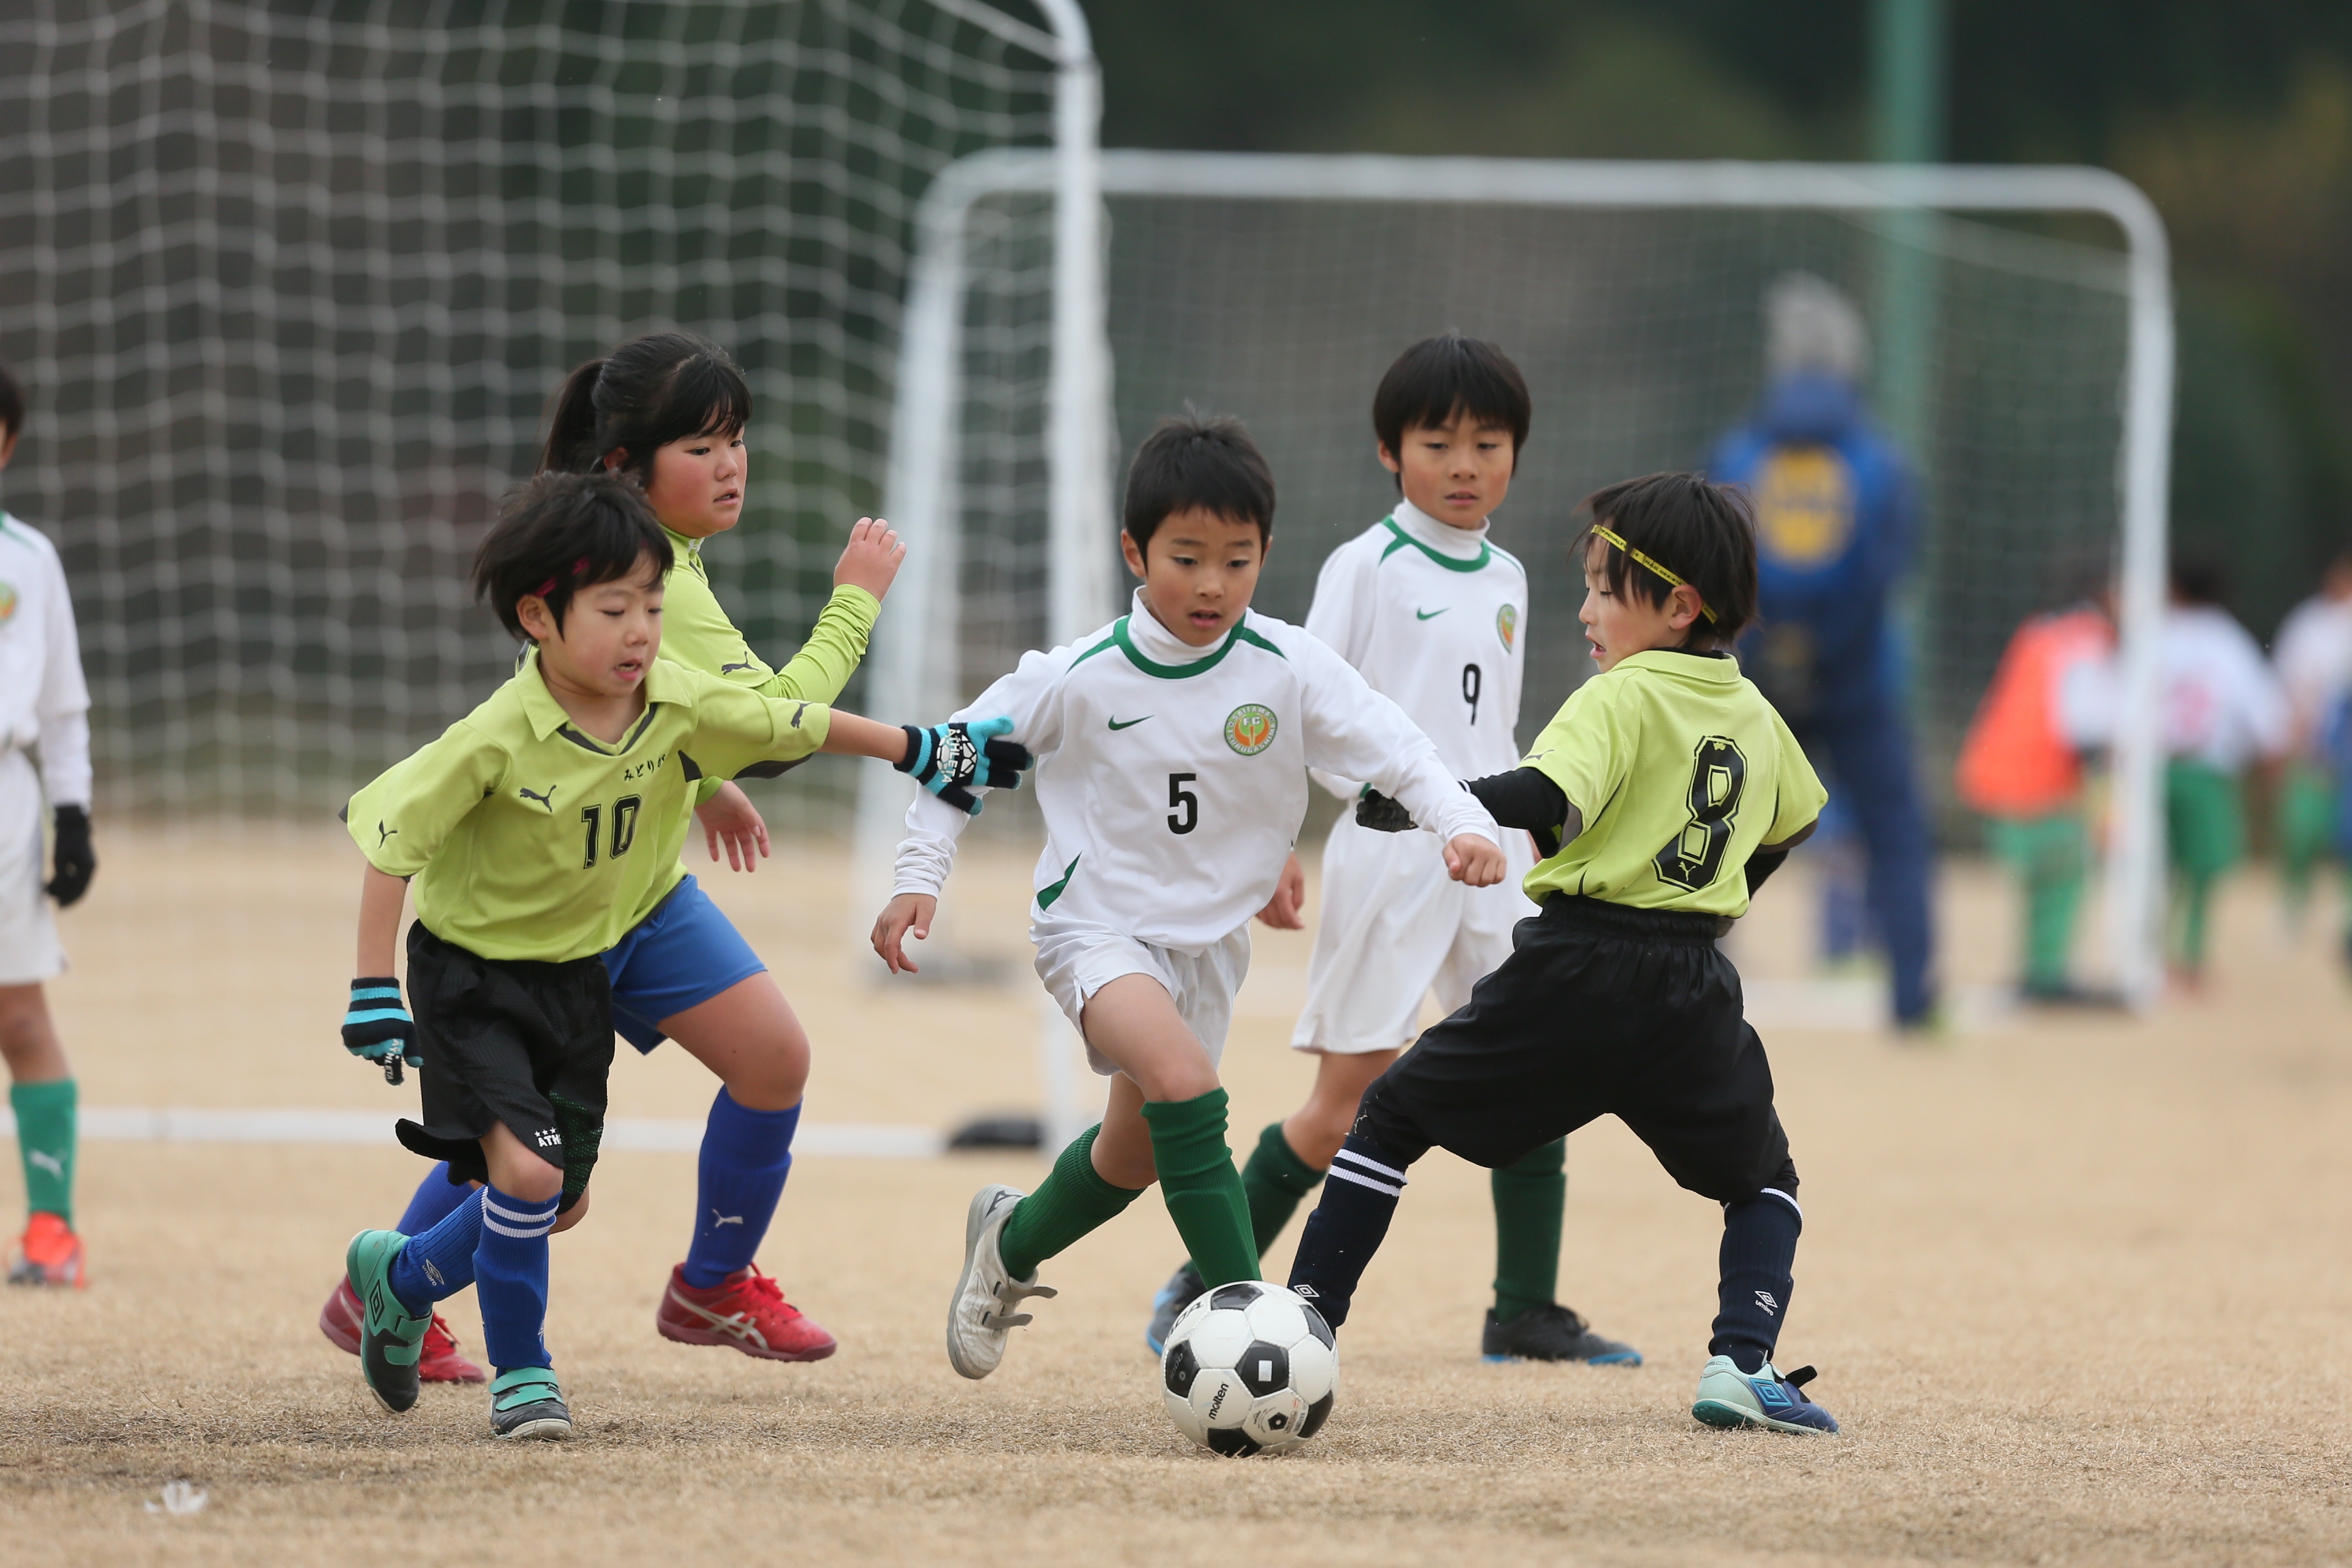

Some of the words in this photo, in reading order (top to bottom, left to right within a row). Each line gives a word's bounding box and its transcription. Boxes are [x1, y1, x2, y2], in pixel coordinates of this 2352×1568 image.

[1232, 706, 1271, 721] SAITAMA
[1463, 664, 1481, 726] 9
[1243, 716, 1261, 726] FC
[941, 728, 960, 783] ATHLETA
[1167, 773, 1198, 834] 5
[1651, 734, 1748, 893] 8
[581, 793, 642, 870] 10
[538, 1134, 562, 1147] ATH
[422, 1265, 437, 1286] umbro
[1755, 1299, 1774, 1316] umbro
[1209, 1382, 1230, 1420] molten
